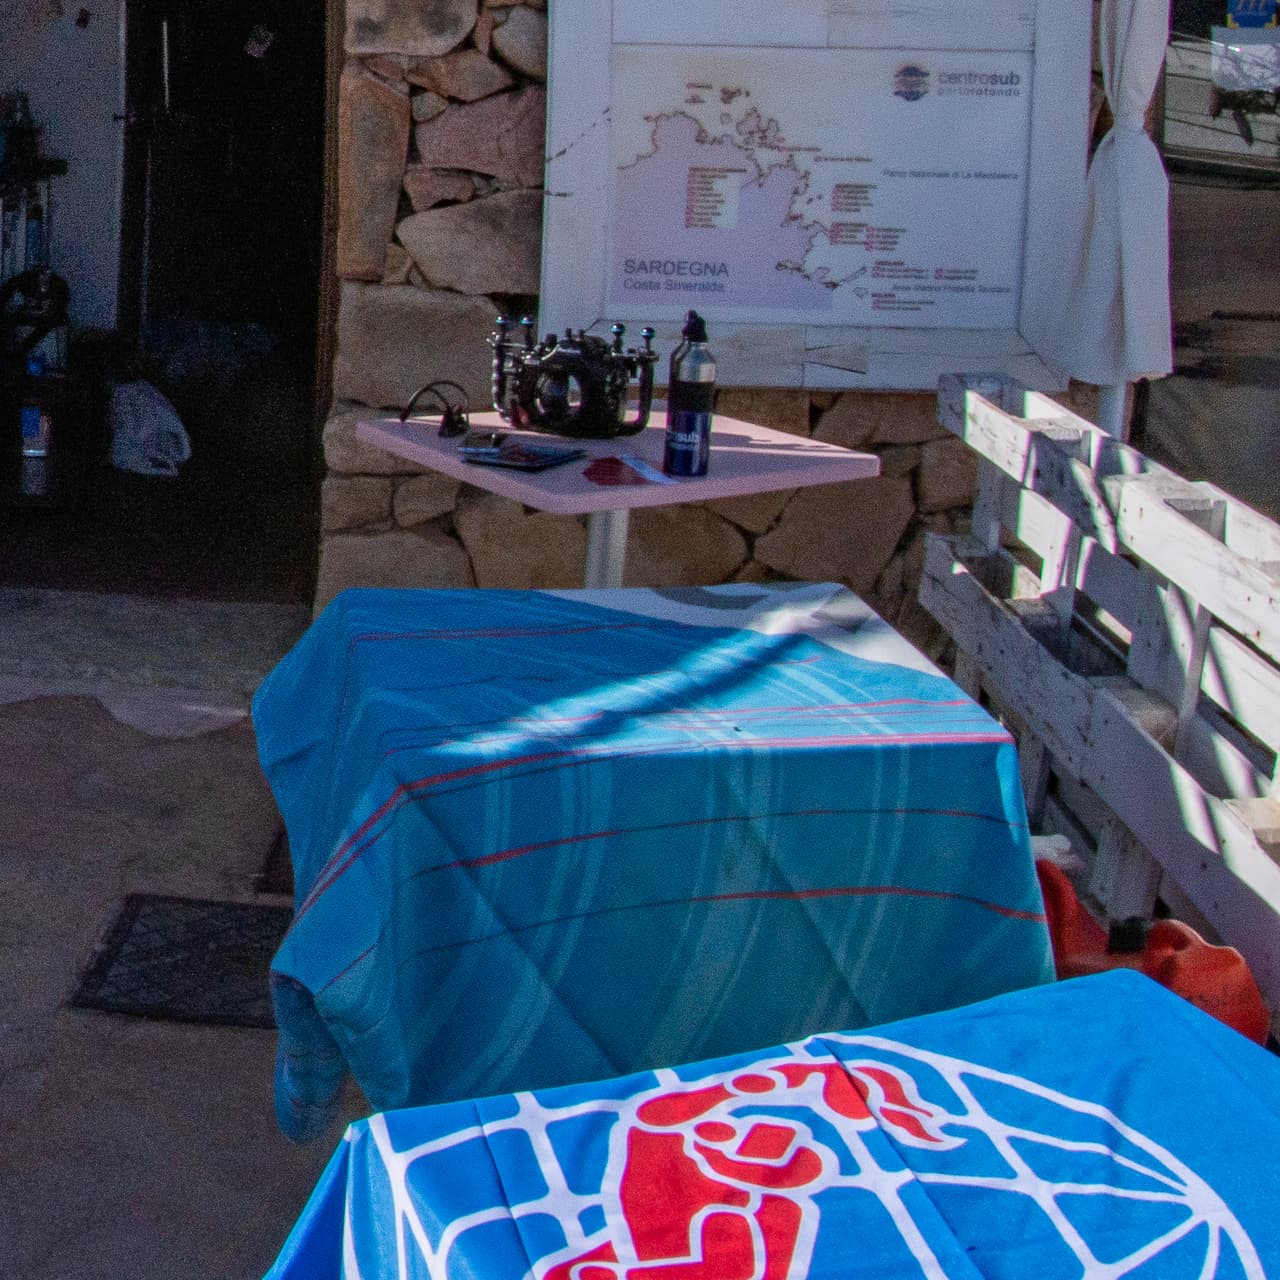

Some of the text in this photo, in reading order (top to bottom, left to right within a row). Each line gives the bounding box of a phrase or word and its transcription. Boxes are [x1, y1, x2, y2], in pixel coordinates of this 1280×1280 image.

[938, 71, 1021, 86] centrosub
[623, 258, 730, 278] SARDEGNA
[623, 278, 726, 292] Costa Smeralda
